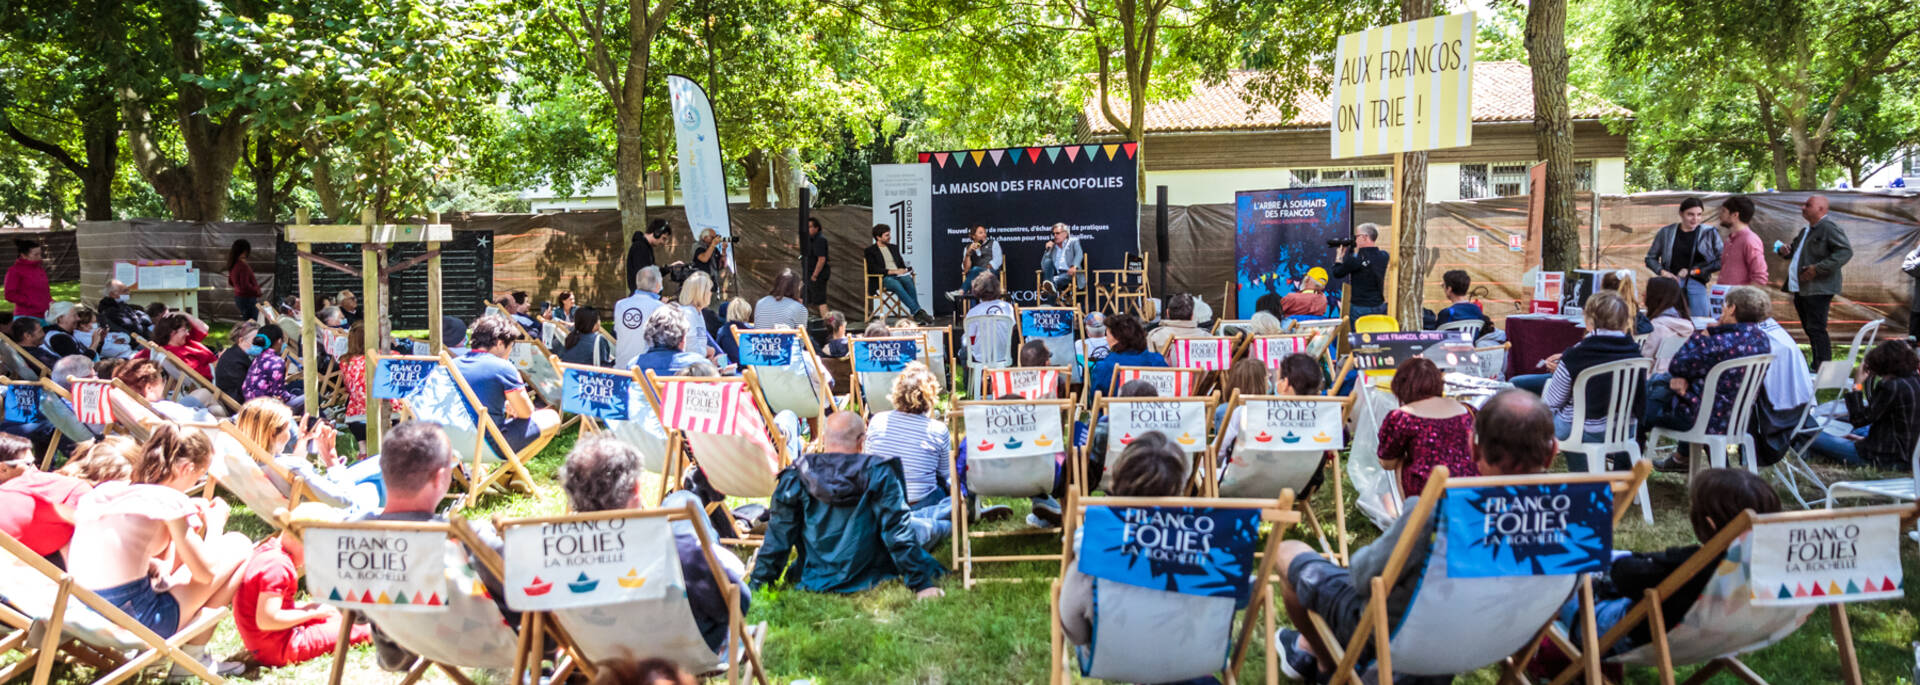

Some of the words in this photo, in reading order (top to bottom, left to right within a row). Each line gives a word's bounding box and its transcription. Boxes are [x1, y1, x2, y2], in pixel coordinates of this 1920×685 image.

[1339, 54, 1372, 86] AUX
[1380, 40, 1467, 80] FRANCOS,
[1337, 103, 1360, 132] ON
[1370, 96, 1406, 128] TRIE
[1417, 95, 1422, 124] !
[932, 184, 947, 194] LA
[950, 182, 998, 194] MAISON
[1002, 180, 1024, 192] DES
[1027, 176, 1124, 190] FRANCOFOLIES
[1254, 201, 1281, 210] L'ARBRE
[1290, 198, 1327, 208] SOUHAITS
[1280, 209, 1314, 217] FRANCOS
[907, 230, 912, 242] UN
[907, 245, 912, 254] LE
[752, 344, 782, 352] FOLIES
[869, 349, 901, 358] FOLIES
[390, 364, 422, 372] FRANCO
[390, 372, 421, 381] FOLIES
[578, 374, 614, 388] FRANCO
[578, 383, 614, 397] FOLIES
[686, 388, 720, 399] FRANCO
[686, 396, 720, 408] FOLIES
[1130, 402, 1181, 410] FRANCO
[1267, 400, 1317, 409] FRANCO
[986, 404, 1036, 417] FRANCO
[1130, 410, 1182, 422] FOLIES
[1267, 409, 1317, 421] FOLIES
[986, 413, 1037, 428] FOLIES
[1485, 494, 1571, 514] FRANCO
[542, 518, 626, 536] FRANCO
[1125, 508, 1215, 534] FRANCO
[1484, 511, 1569, 534] FOLIES
[1122, 522, 1214, 554] FOLIES
[1483, 535, 1501, 546] LA
[1506, 532, 1566, 545] ROCHELLE
[1789, 524, 1860, 543] FRANCO
[338, 536, 408, 552] FRANCO
[543, 531, 626, 556] FOLIES
[1121, 544, 1138, 556] LA
[1144, 549, 1207, 566] ROCHELLE
[1787, 540, 1858, 563] FOLIES
[338, 552, 408, 572] FOLIES
[544, 560, 561, 569] LA
[566, 552, 625, 567] ROCHELLE
[1786, 564, 1800, 573] LA
[1806, 560, 1858, 572] ROCHELLE
[338, 570, 354, 580] LA
[358, 572, 408, 582] ROCHELLE
